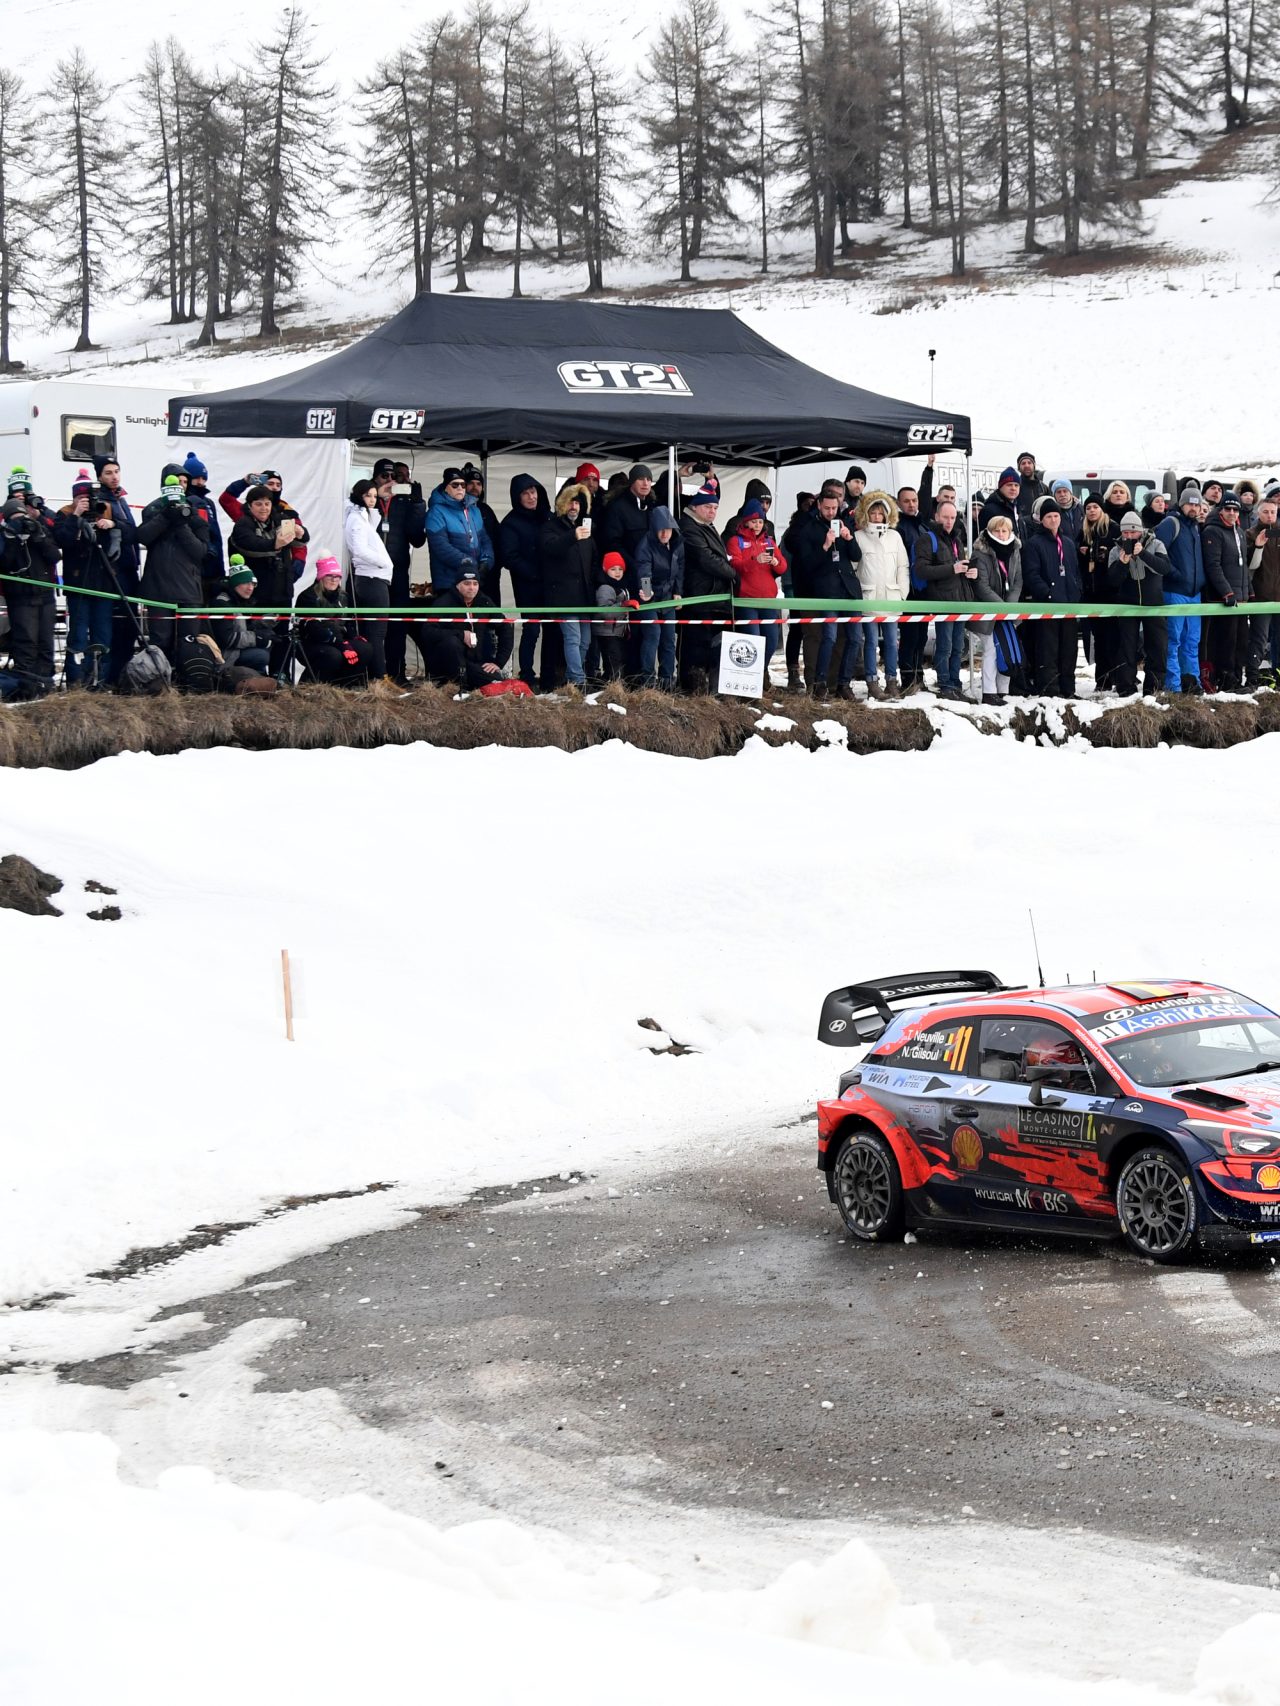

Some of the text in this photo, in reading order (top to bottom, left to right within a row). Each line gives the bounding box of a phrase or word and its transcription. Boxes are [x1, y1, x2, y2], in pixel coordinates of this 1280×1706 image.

[557, 361, 692, 392] GT2i
[126, 415, 167, 427] Sunlight
[180, 407, 209, 428] GT2i
[306, 408, 337, 430] GT2i
[370, 408, 425, 430] GT2i
[908, 424, 954, 442] GT2i
[1135, 997, 1206, 1012] HYUNDAI
[1124, 1004, 1251, 1033] AsahiKASEI
[914, 1030, 945, 1044] Neuville
[1097, 1026, 1120, 1039] 11
[911, 1047, 940, 1061] Gilsoul
[950, 1026, 974, 1072] 11
[1020, 1109, 1081, 1128] LE CASINO
[974, 1187, 1069, 1213] HYUNDAI MOBIS
